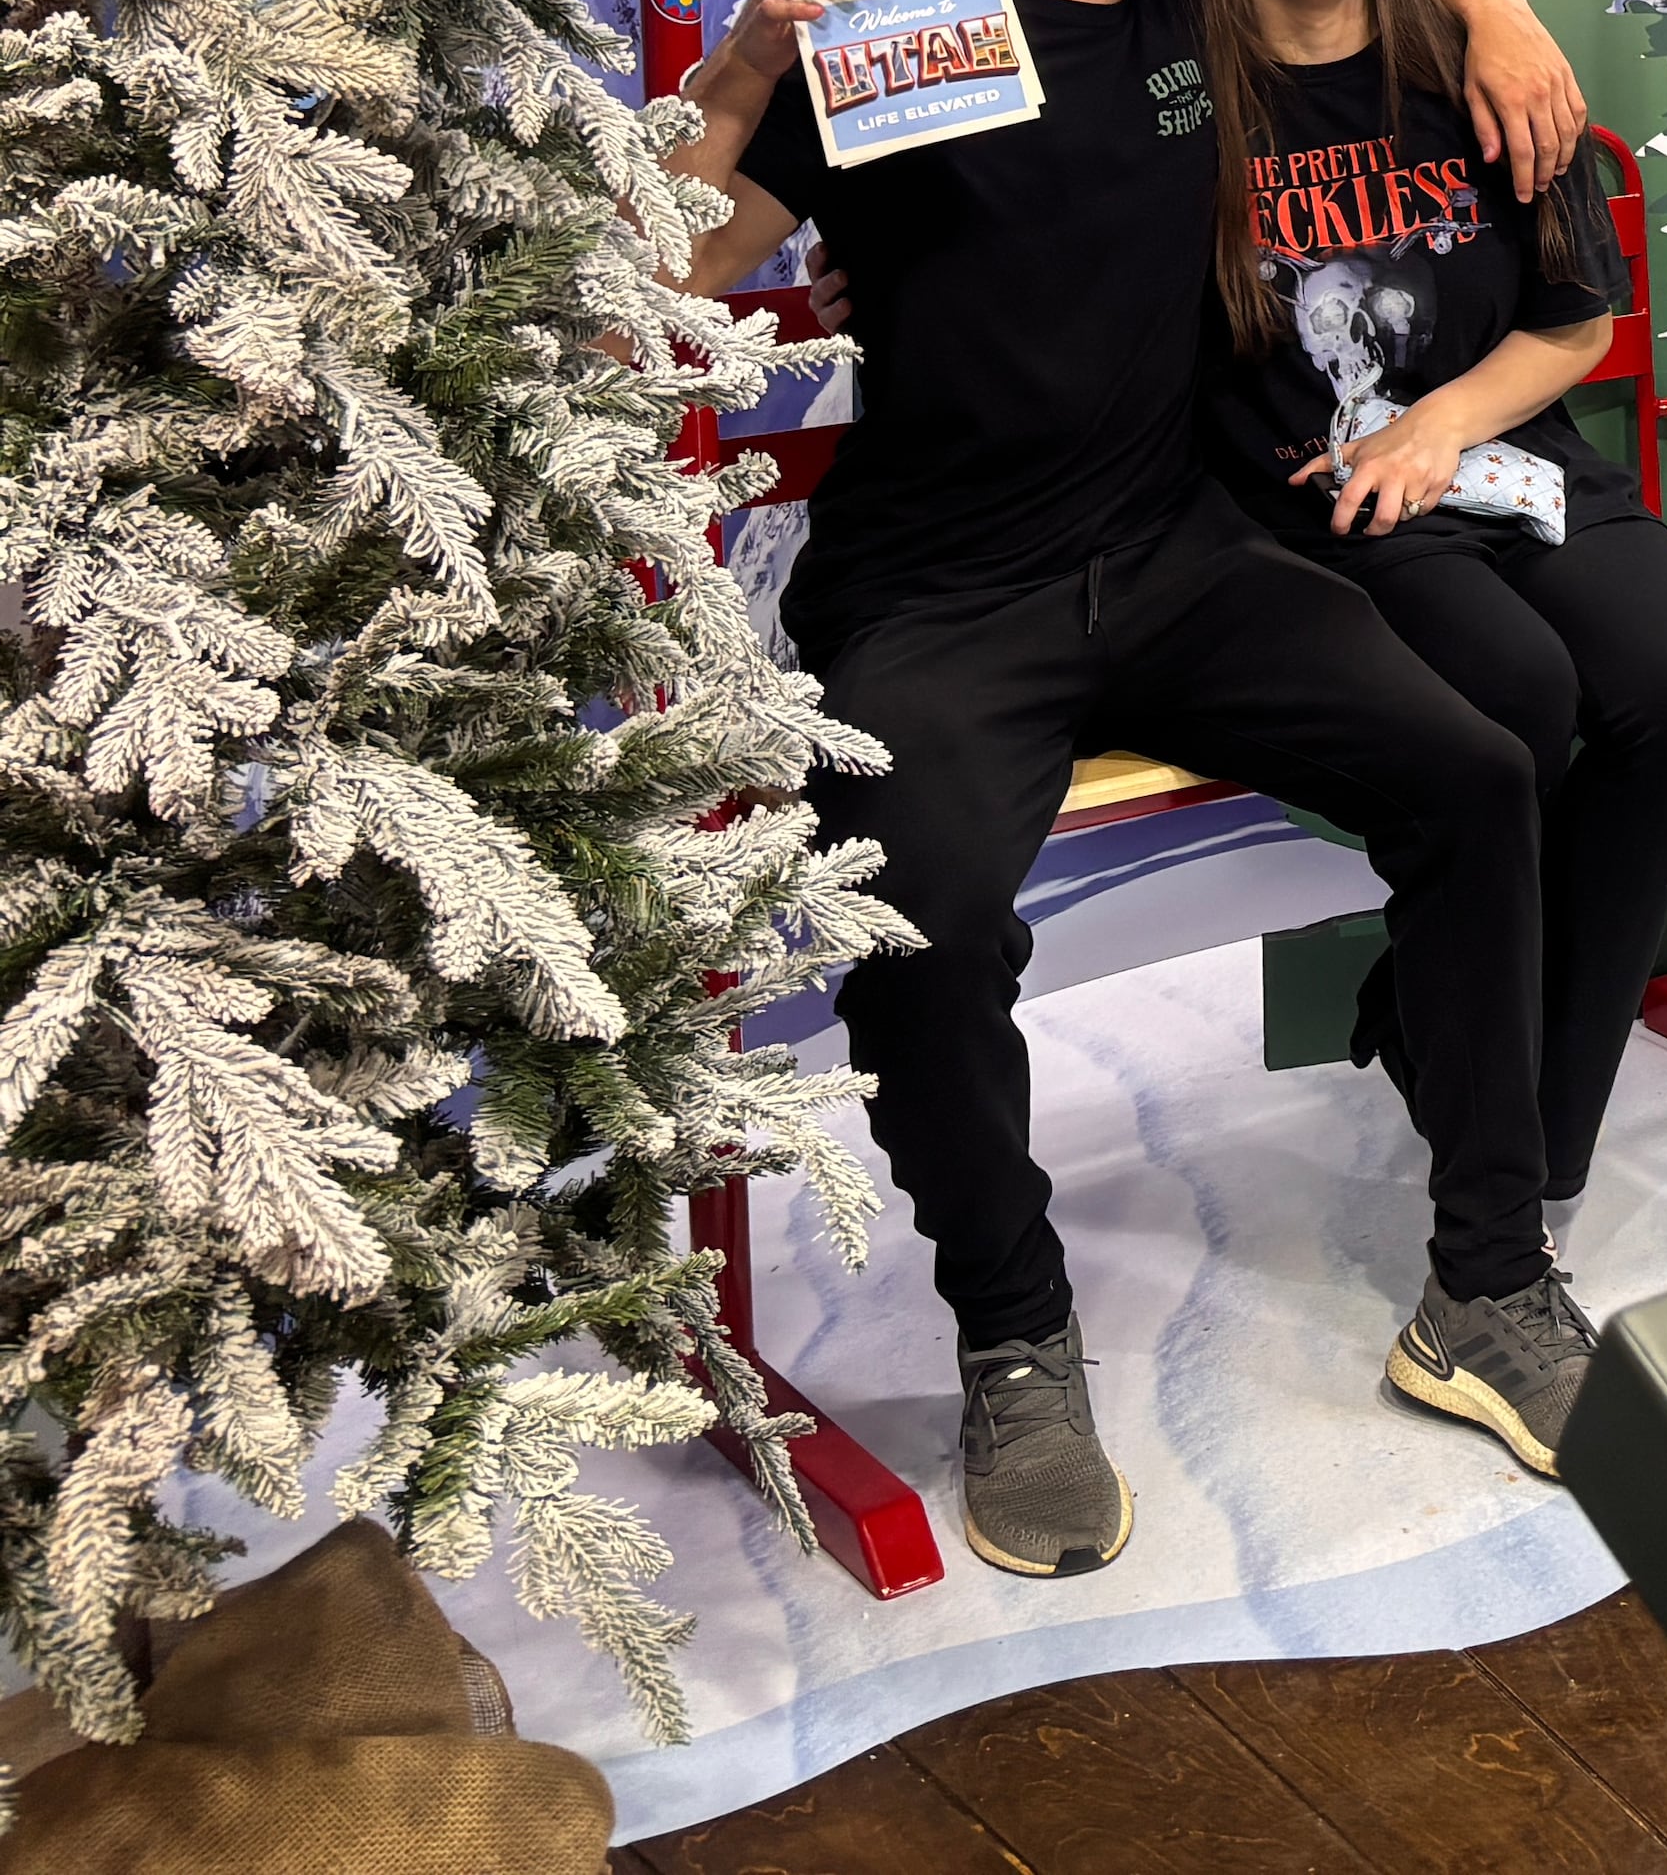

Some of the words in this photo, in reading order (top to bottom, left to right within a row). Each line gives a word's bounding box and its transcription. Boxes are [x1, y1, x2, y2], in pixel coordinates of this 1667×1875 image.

[849, 6, 937, 34] Welcome
[813, 12, 1021, 119] UTAH
[857, 113, 900, 132] LIFE
[904, 89, 1000, 121] ELEVATED
[1157, 91, 1214, 137] SHIPS
[1287, 134, 1398, 187] PRETTY
[1250, 158, 1479, 253] ECKLESS
